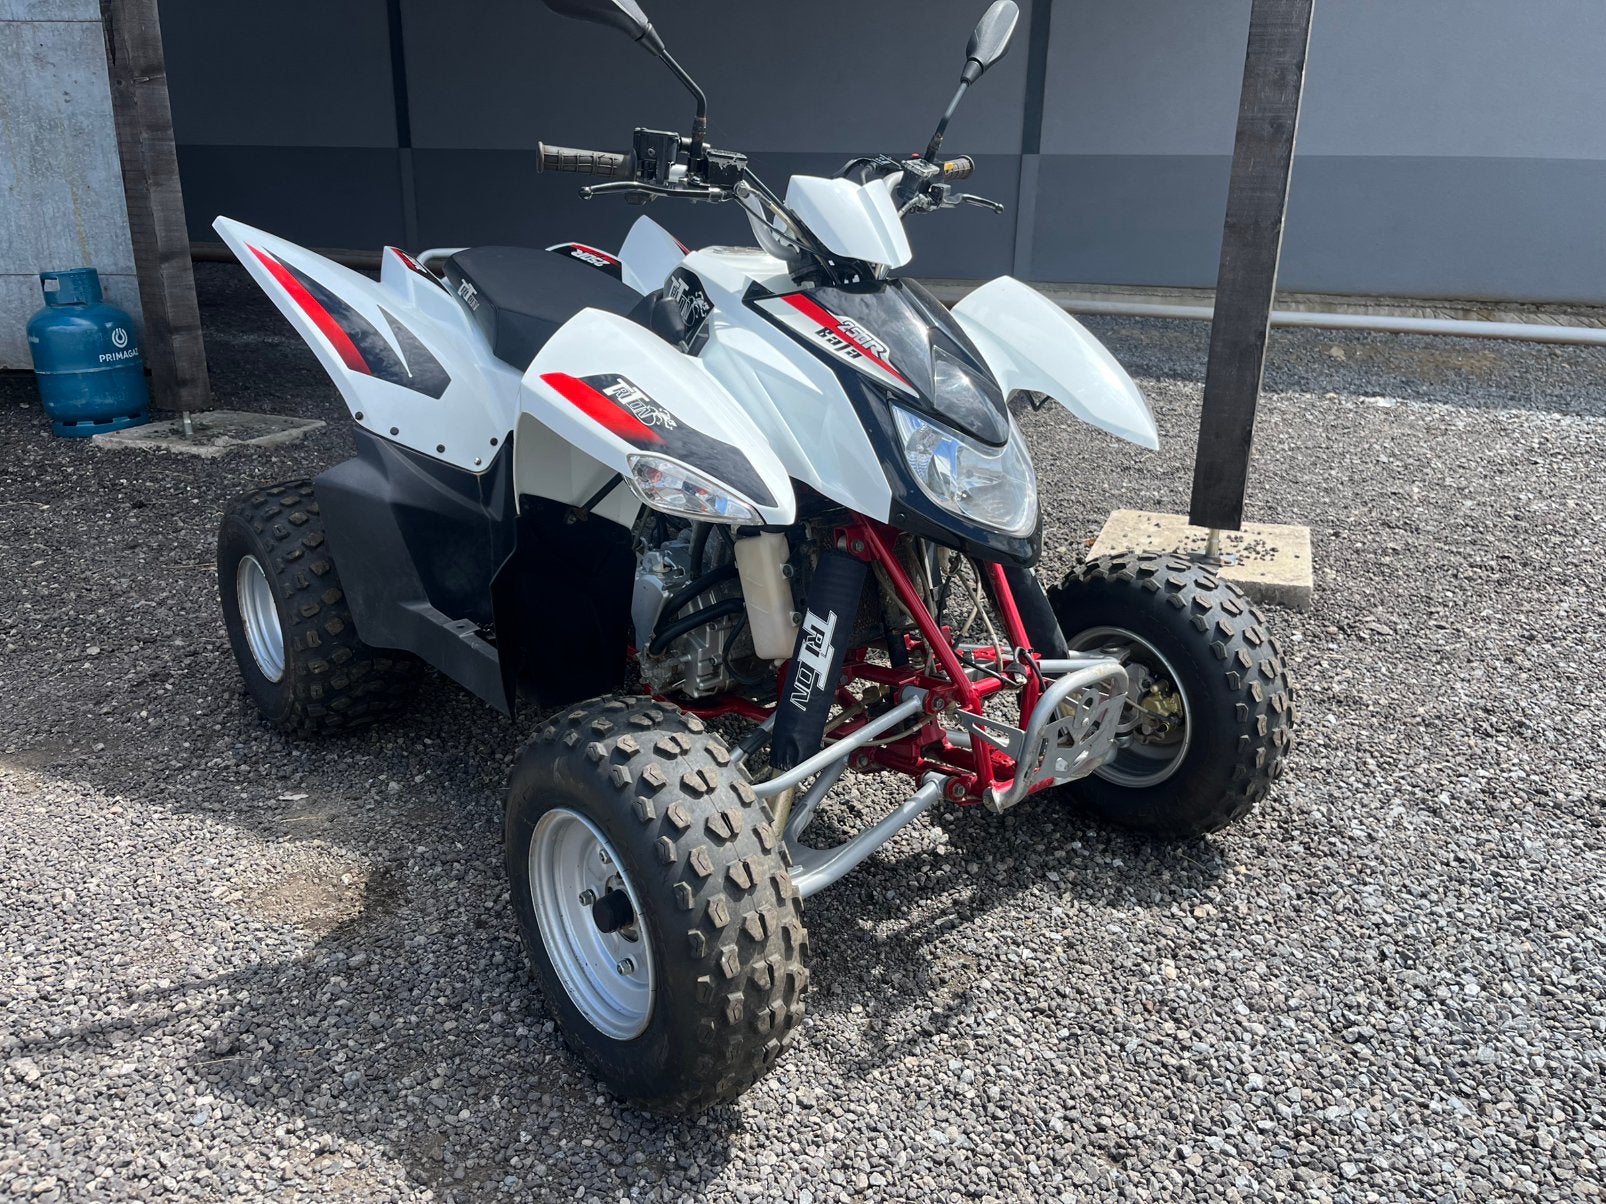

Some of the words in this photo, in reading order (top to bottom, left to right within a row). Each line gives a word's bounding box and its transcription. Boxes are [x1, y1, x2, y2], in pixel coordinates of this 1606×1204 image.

[99, 348, 139, 363] PRIMAGAZ
[835, 320, 889, 361] 250R
[602, 377, 651, 420] TRITON
[789, 607, 838, 712] TRITON
